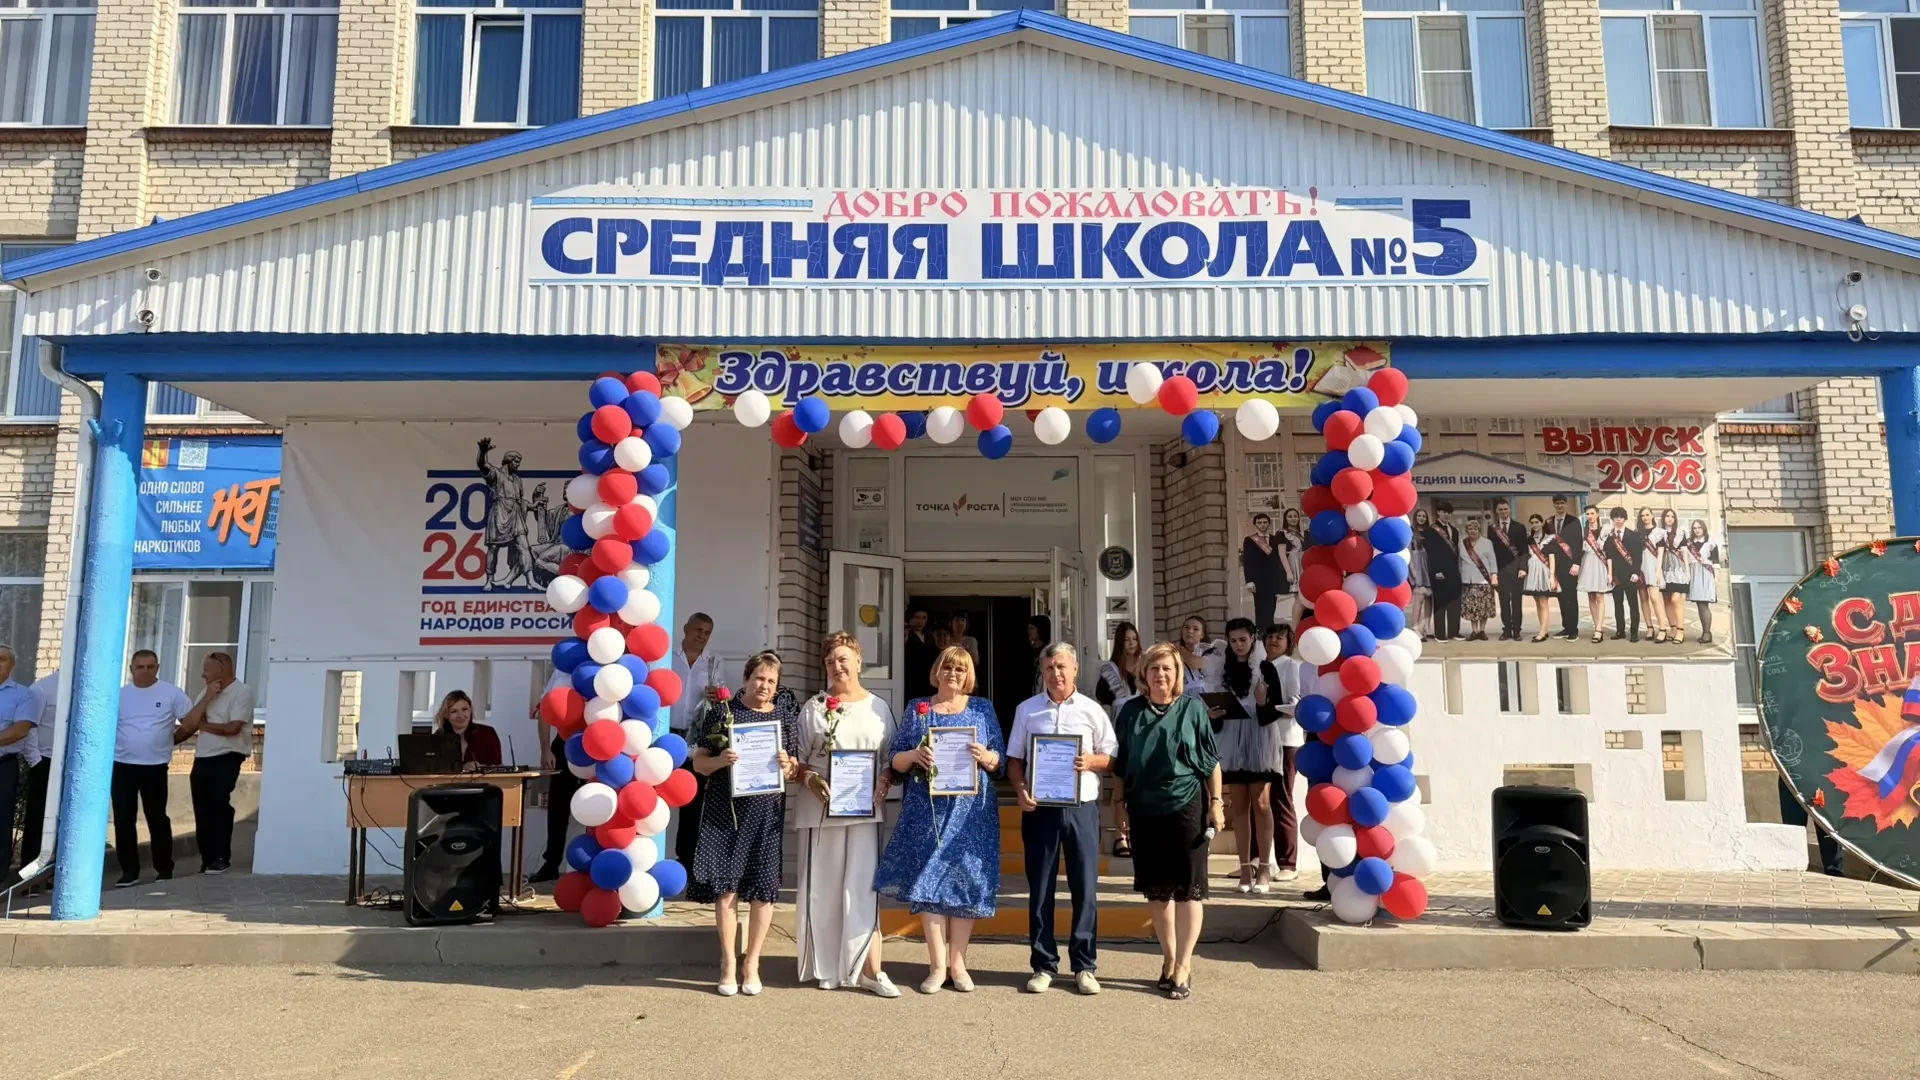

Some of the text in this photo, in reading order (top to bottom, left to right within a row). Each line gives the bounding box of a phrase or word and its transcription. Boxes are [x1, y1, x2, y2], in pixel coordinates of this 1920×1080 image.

[823, 186, 1318, 222] ДОБРО ПОЖАЛОВАТЬ!
[541, 217, 948, 286] СРЕДНЯЯ
[981, 219, 1344, 280] ШКОЛА
[714, 350, 1082, 406] Здравствуй,
[1541, 425, 1706, 456] ВЫПУСК
[1460, 475, 1507, 485] ШКОЛА
[1598, 457, 1705, 493] 2026
[140, 480, 205, 496] ОДНО СЛОВО
[155, 500, 203, 514] СИЛЬНЕЕ
[425, 482, 492, 531] 20
[915, 503, 1000, 511] ТОЧКА РОСТА
[160, 519, 202, 534] ЛЮБЫХ
[134, 539, 201, 554] НАРКОТИКОВ
[422, 532, 487, 581] 26
[421, 600, 457, 615] ГОД
[420, 617, 573, 632] НАРОДОВ РОССИ
